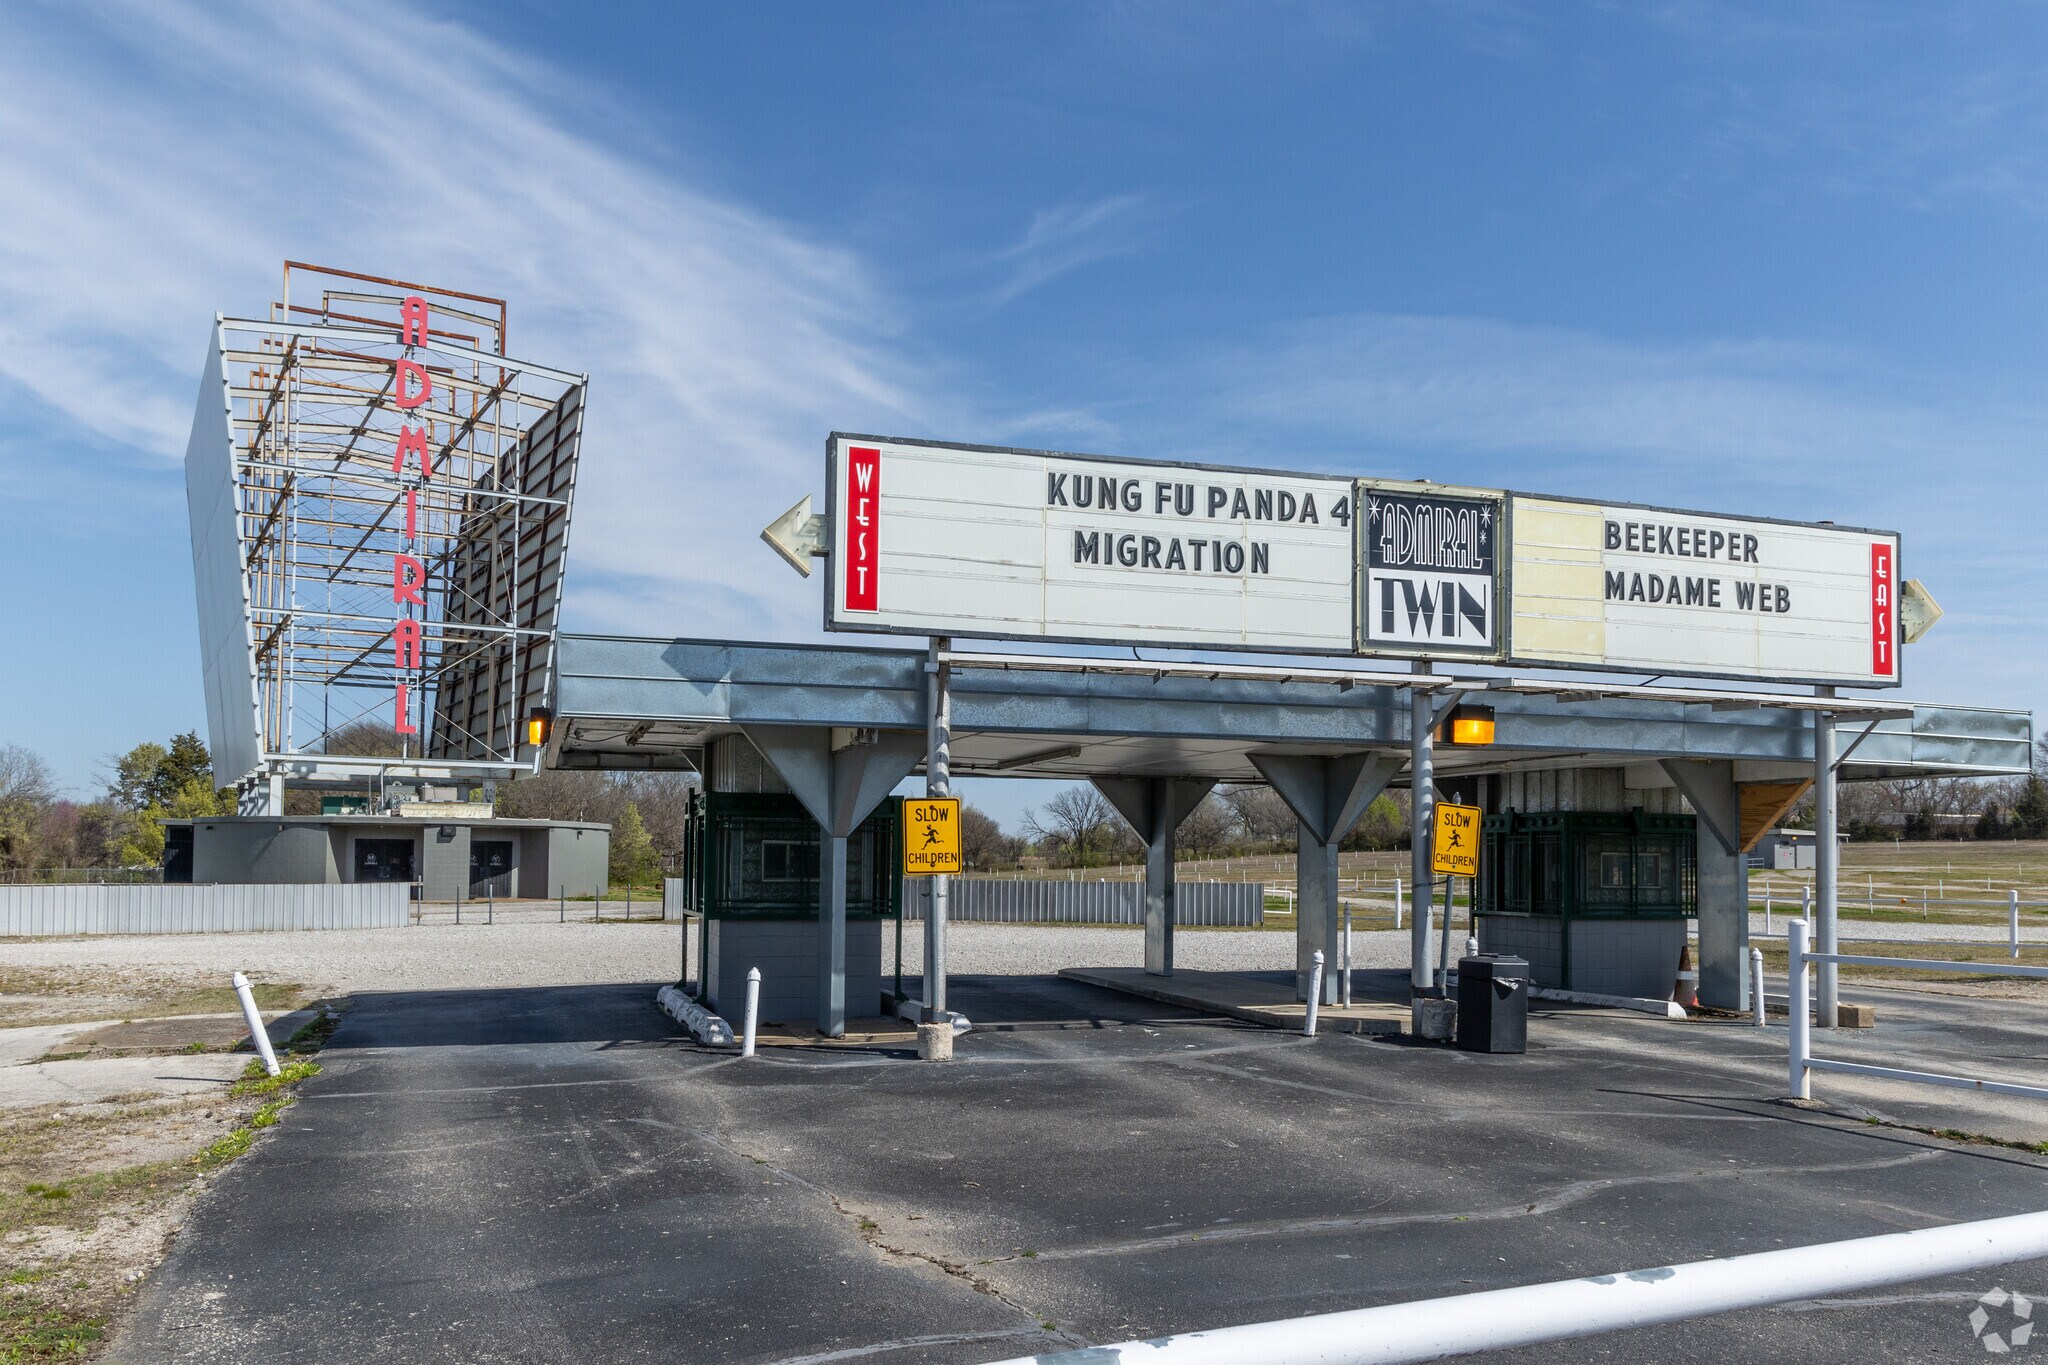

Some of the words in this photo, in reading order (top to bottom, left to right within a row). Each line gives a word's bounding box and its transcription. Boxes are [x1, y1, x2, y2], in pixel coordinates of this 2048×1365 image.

[391, 296, 432, 734] ADMIRAL
[1047, 472, 1142, 512] KUNG
[1155, 481, 1195, 516] FU
[1207, 486, 1319, 524] PANDA
[1330, 495, 1350, 527] 4
[855, 462, 874, 595] WEST
[1380, 503, 1483, 569] ADMIRAL
[1604, 520, 1759, 563] BEEKEEPER
[1074, 530, 1269, 574] MIGRATION
[1374, 577, 1486, 640] TWIN
[1605, 570, 1721, 608] MADAME
[1735, 581, 1791, 613] WEB
[1875, 556, 1887, 663] EAST
[915, 807, 948, 822] SLOW
[1444, 812, 1470, 828] SLOW
[908, 852, 957, 864] CHILDREN
[1435, 852, 1474, 867] CHILDREN
